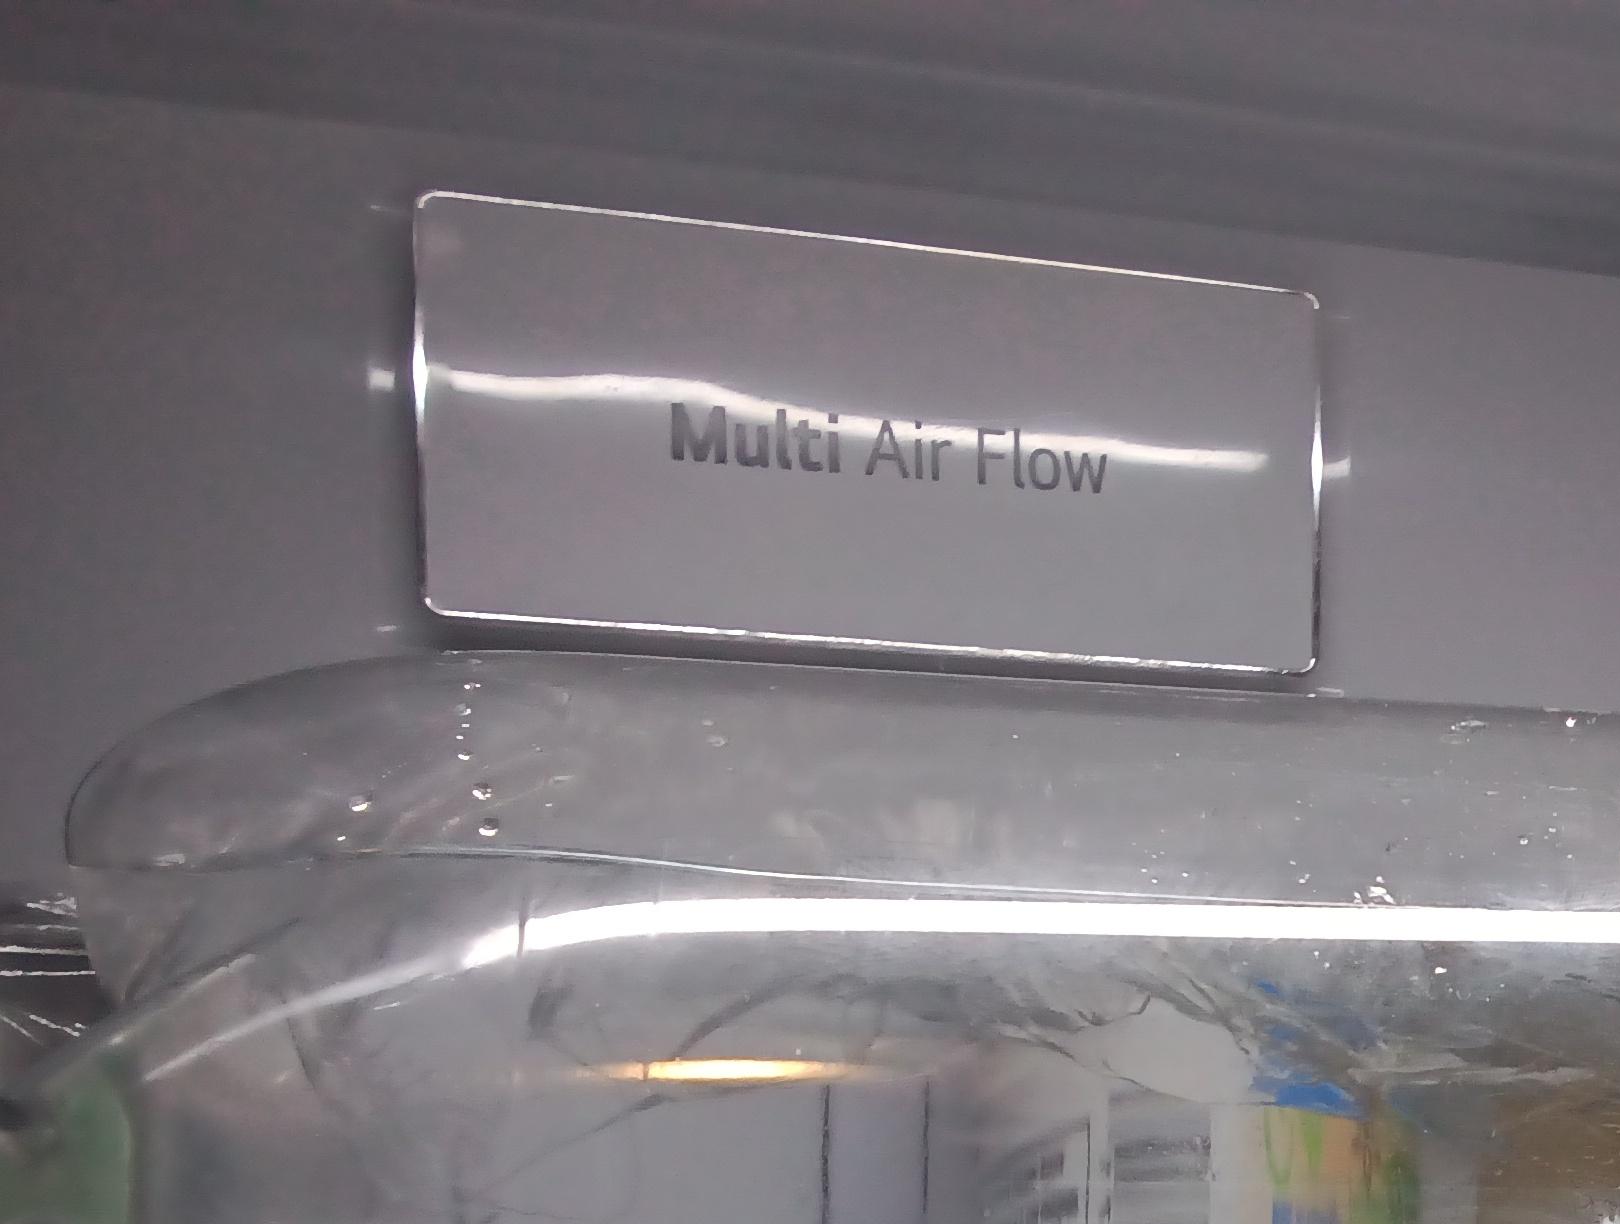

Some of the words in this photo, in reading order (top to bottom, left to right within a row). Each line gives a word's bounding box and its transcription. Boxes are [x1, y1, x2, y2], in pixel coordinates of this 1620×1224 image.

[671, 401, 841, 474] Multi
[864, 420, 952, 482] Air
[977, 427, 1108, 494] Flow
